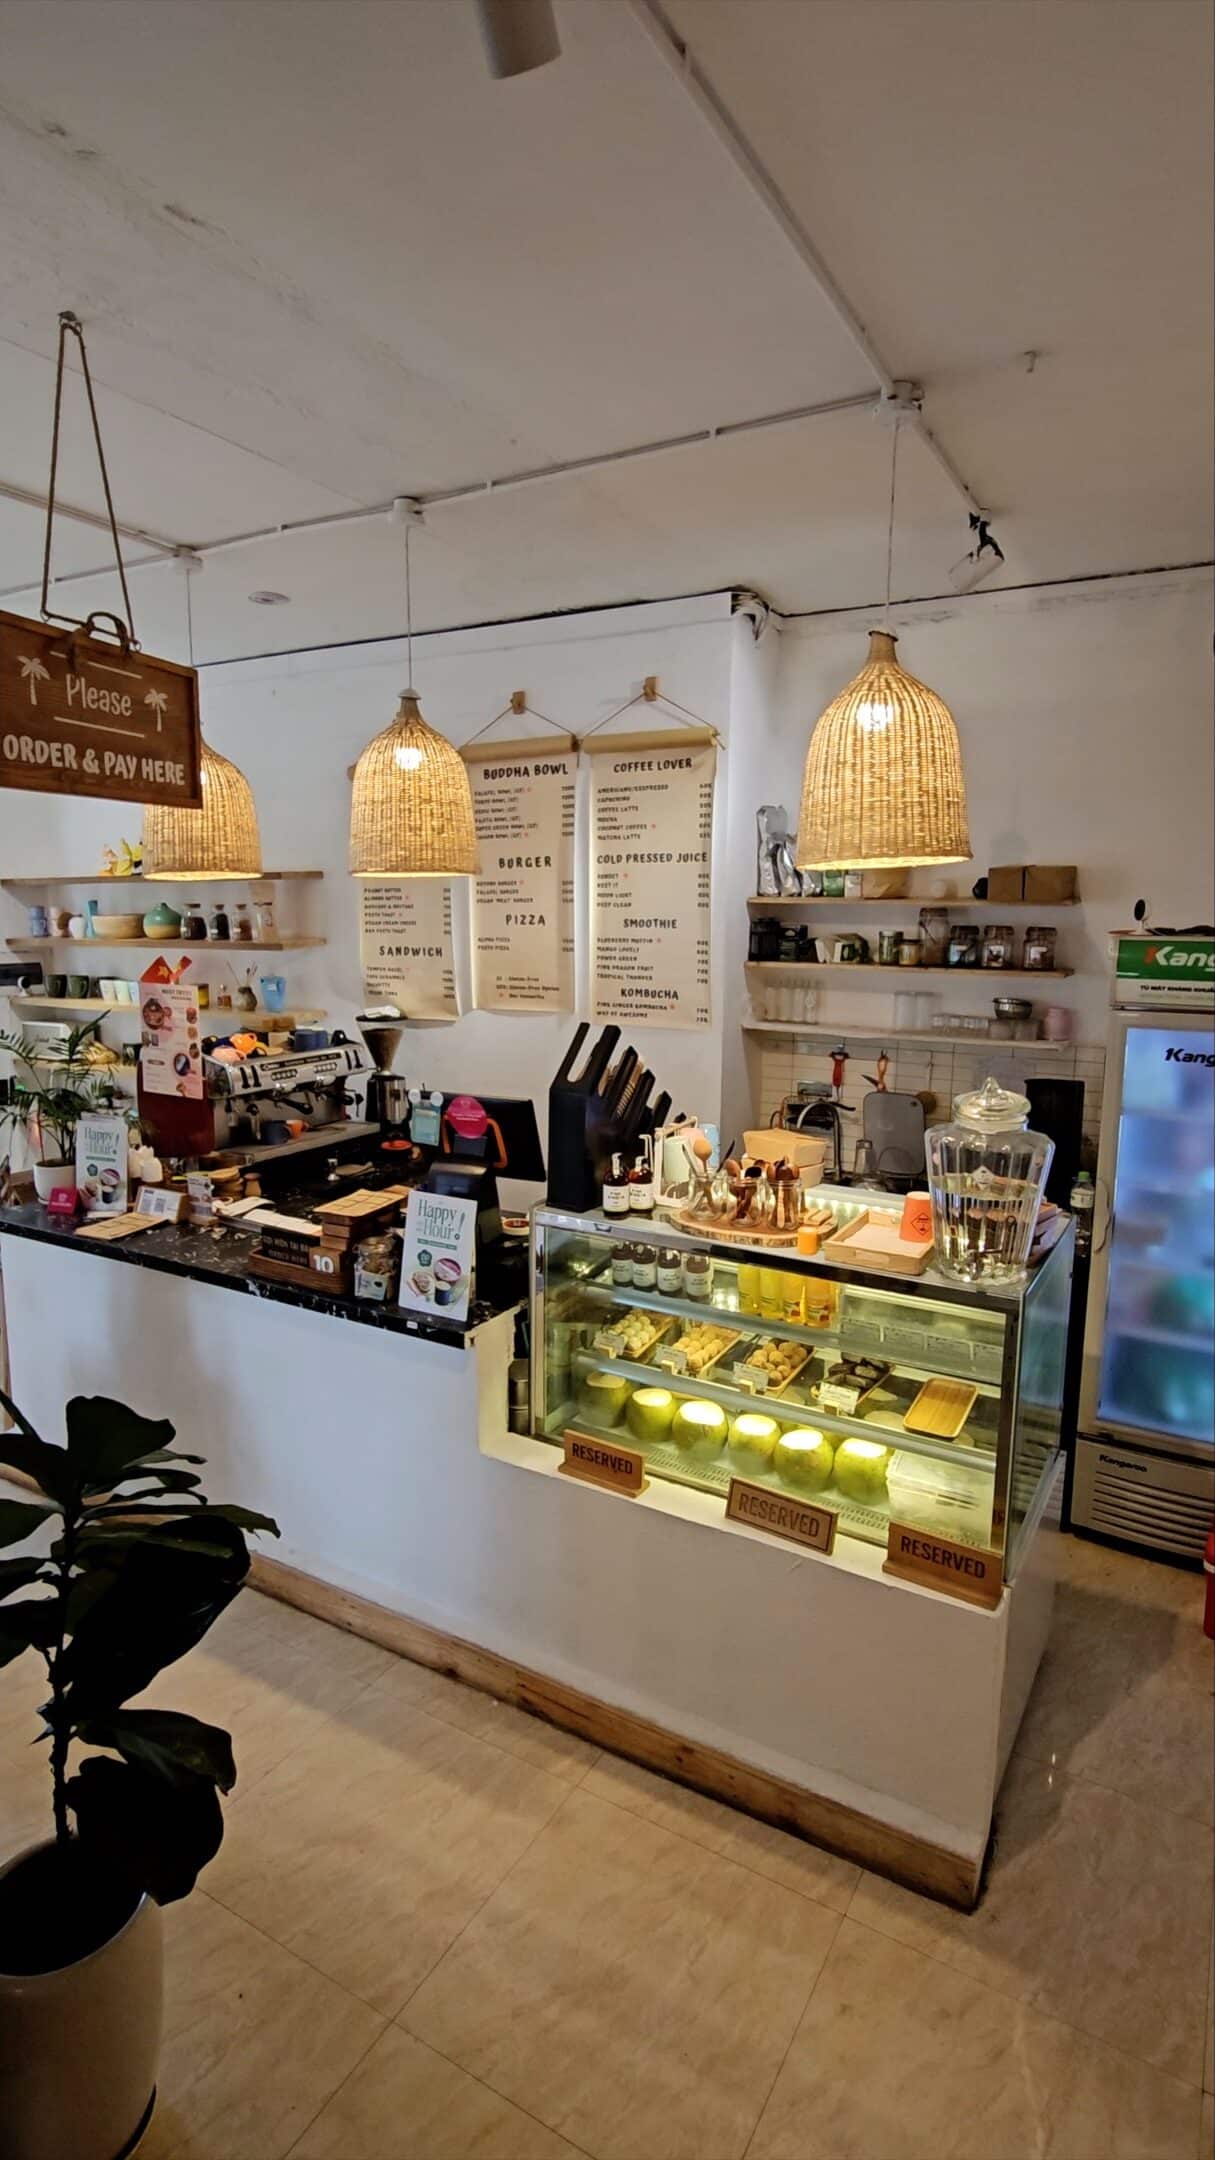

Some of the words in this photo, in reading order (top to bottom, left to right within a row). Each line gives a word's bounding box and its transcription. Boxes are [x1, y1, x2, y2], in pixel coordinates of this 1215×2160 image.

[66, 673, 132, 716] Please
[3, 734, 78, 770] ORDER
[82, 749, 100, 775] &
[104, 752, 137, 780] PAY
[141, 758, 185, 785] HERE
[614, 761, 653, 773] COFFEE
[657, 758, 692, 771] LOVER
[483, 766, 530, 779] BUDDHA
[534, 763, 568, 776] BOWL
[498, 856, 552, 869] BURGER
[597, 854, 622, 864] COLD
[626, 853, 672, 864] PRESSED
[676, 852, 708, 863] JUICE
[505, 914, 545, 926] PIZZA
[624, 919, 677, 928] SMOOTHIE
[379, 946, 442, 957] SANDWICH
[620, 988, 679, 1000] KOMBUCHA
[84, 1127, 113, 1144] Happy
[418, 1200, 457, 1224] Happy
[313, 1254, 334, 1273] 10
[572, 1442, 633, 1476] RESERVED
[738, 1492, 821, 1539] RESERVED
[901, 1534, 986, 1580] RESERVED
